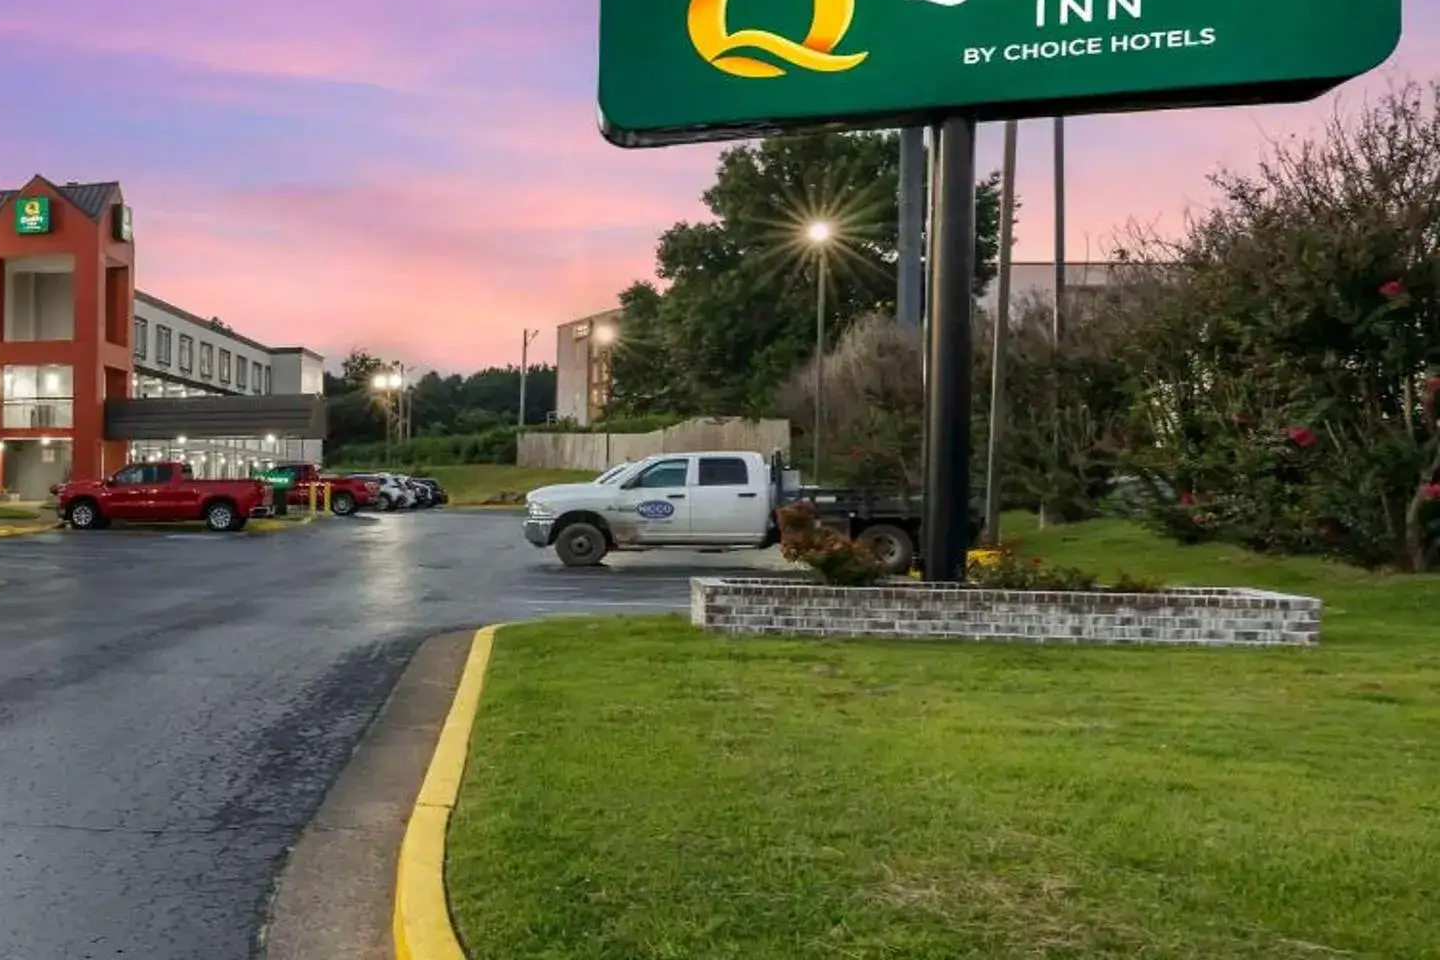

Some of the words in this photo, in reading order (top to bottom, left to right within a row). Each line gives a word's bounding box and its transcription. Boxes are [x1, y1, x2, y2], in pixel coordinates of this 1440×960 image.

[963, 46, 996, 65] BY
[1003, 37, 1103, 61] CHOICE
[1110, 27, 1217, 53] HOTELS
